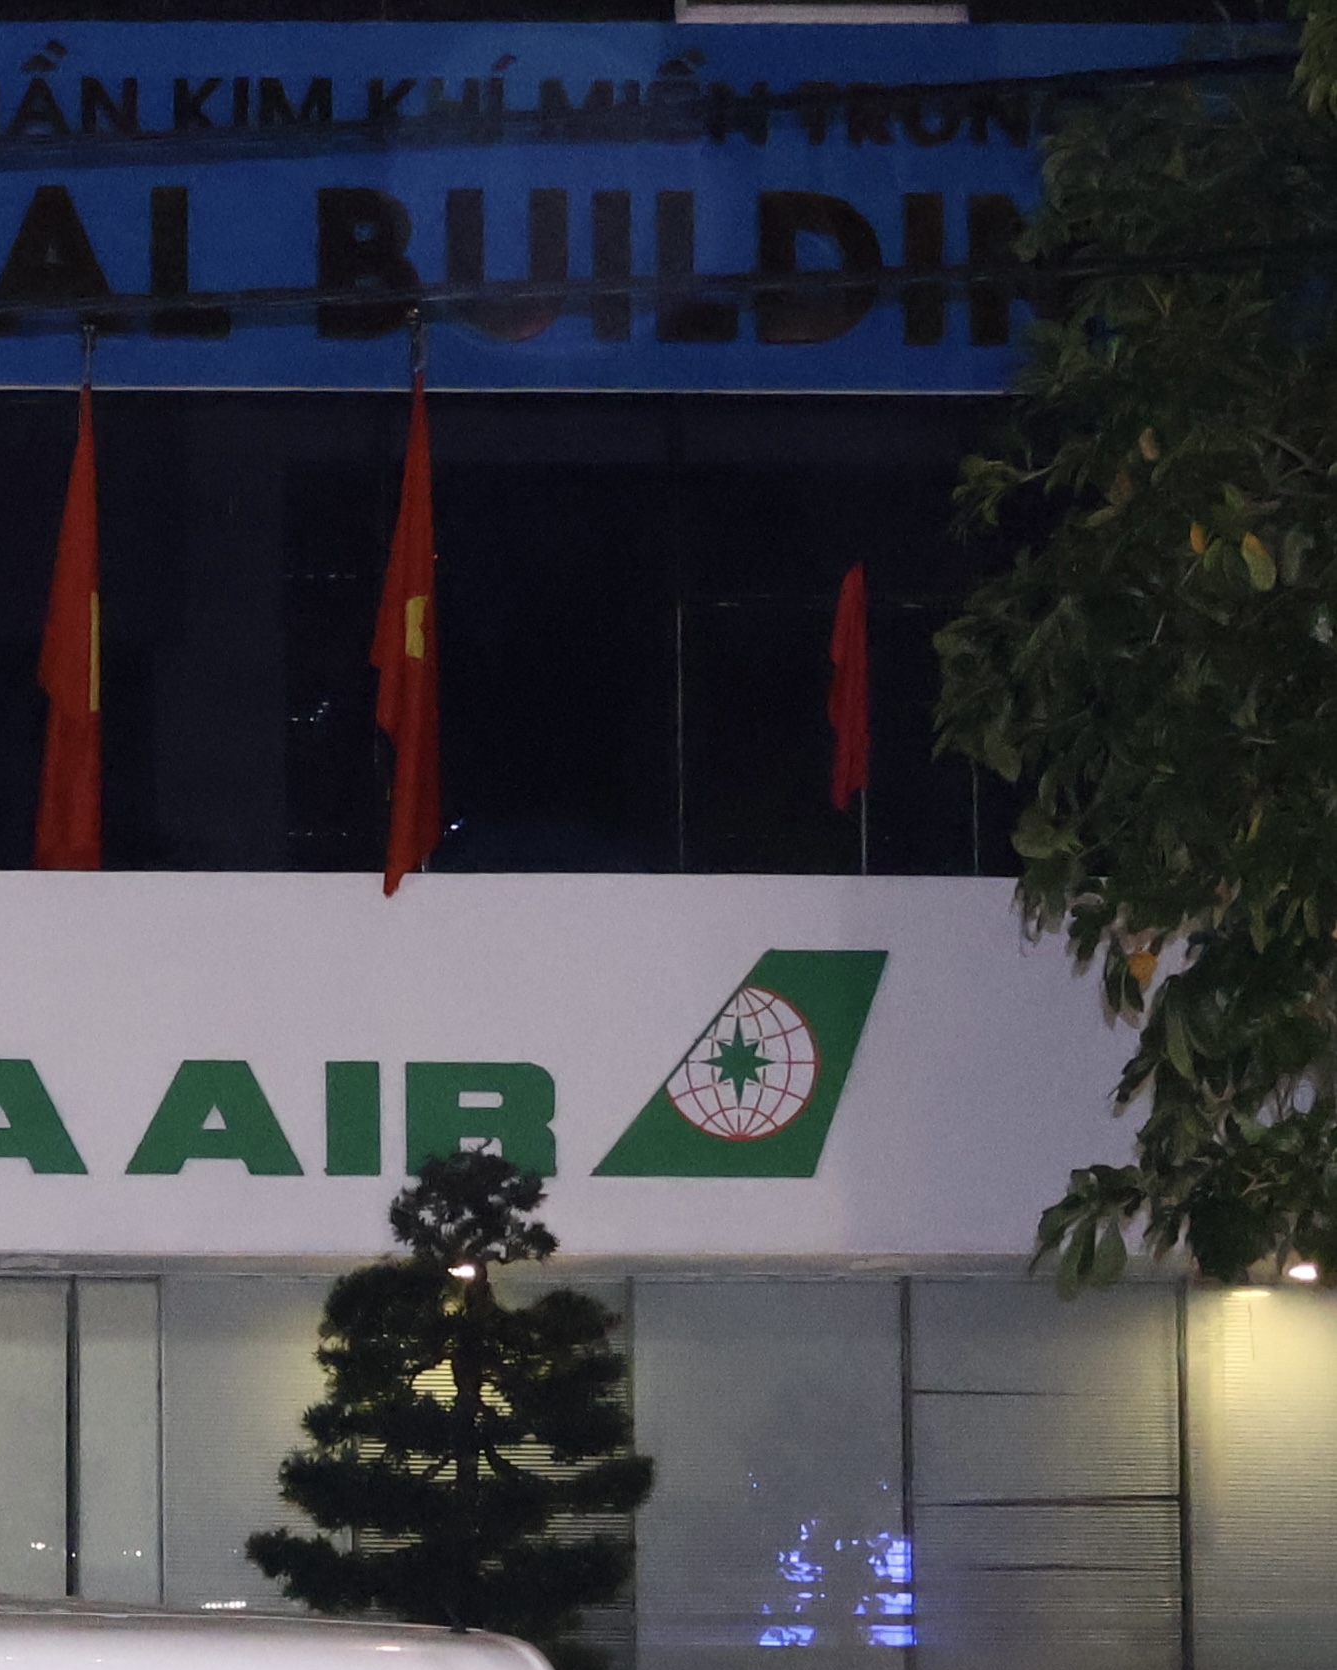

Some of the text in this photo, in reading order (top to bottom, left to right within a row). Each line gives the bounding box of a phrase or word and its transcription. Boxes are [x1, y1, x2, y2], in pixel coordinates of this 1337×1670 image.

[173, 76, 333, 138] KIM
[368, 53, 517, 146] KHÍ
[796, 81, 1047, 148] TRUN
[316, 187, 1060, 345] BUILDIN
[124, 1059, 558, 1176] AIR
